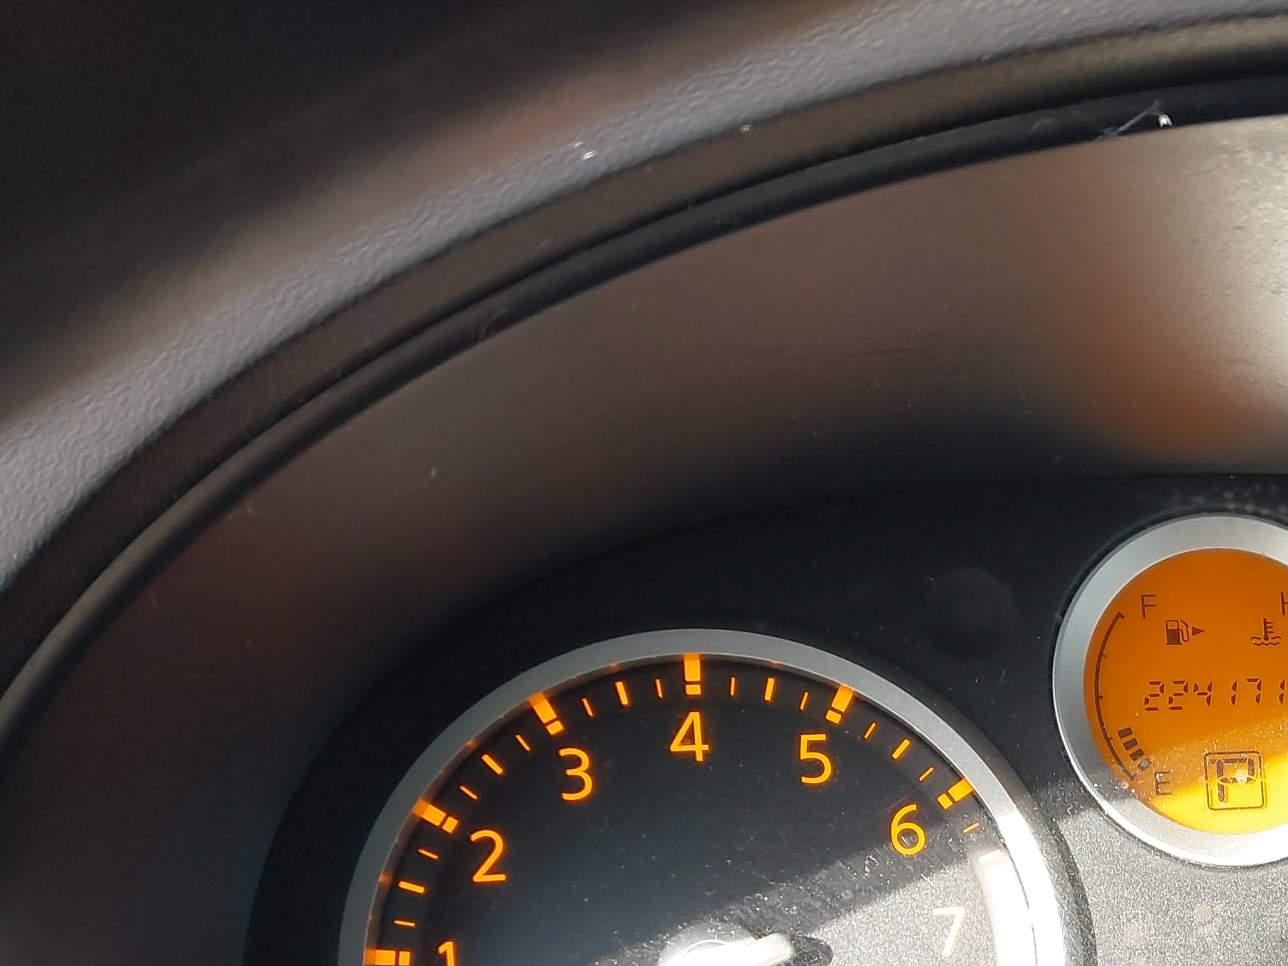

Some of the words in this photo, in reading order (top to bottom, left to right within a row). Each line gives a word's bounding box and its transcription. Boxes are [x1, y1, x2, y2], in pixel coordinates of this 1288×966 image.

[1140, 593, 1157, 619] F
[1143, 677, 1287, 712] 224171
[669, 711, 710, 762] 4
[799, 733, 834, 785] 5
[558, 747, 594, 801] 3
[1154, 770, 1172, 796] E
[1216, 757, 1257, 803] P
[890, 804, 927, 855] 6
[469, 829, 507, 882] 2
[932, 906, 965, 957] 7
